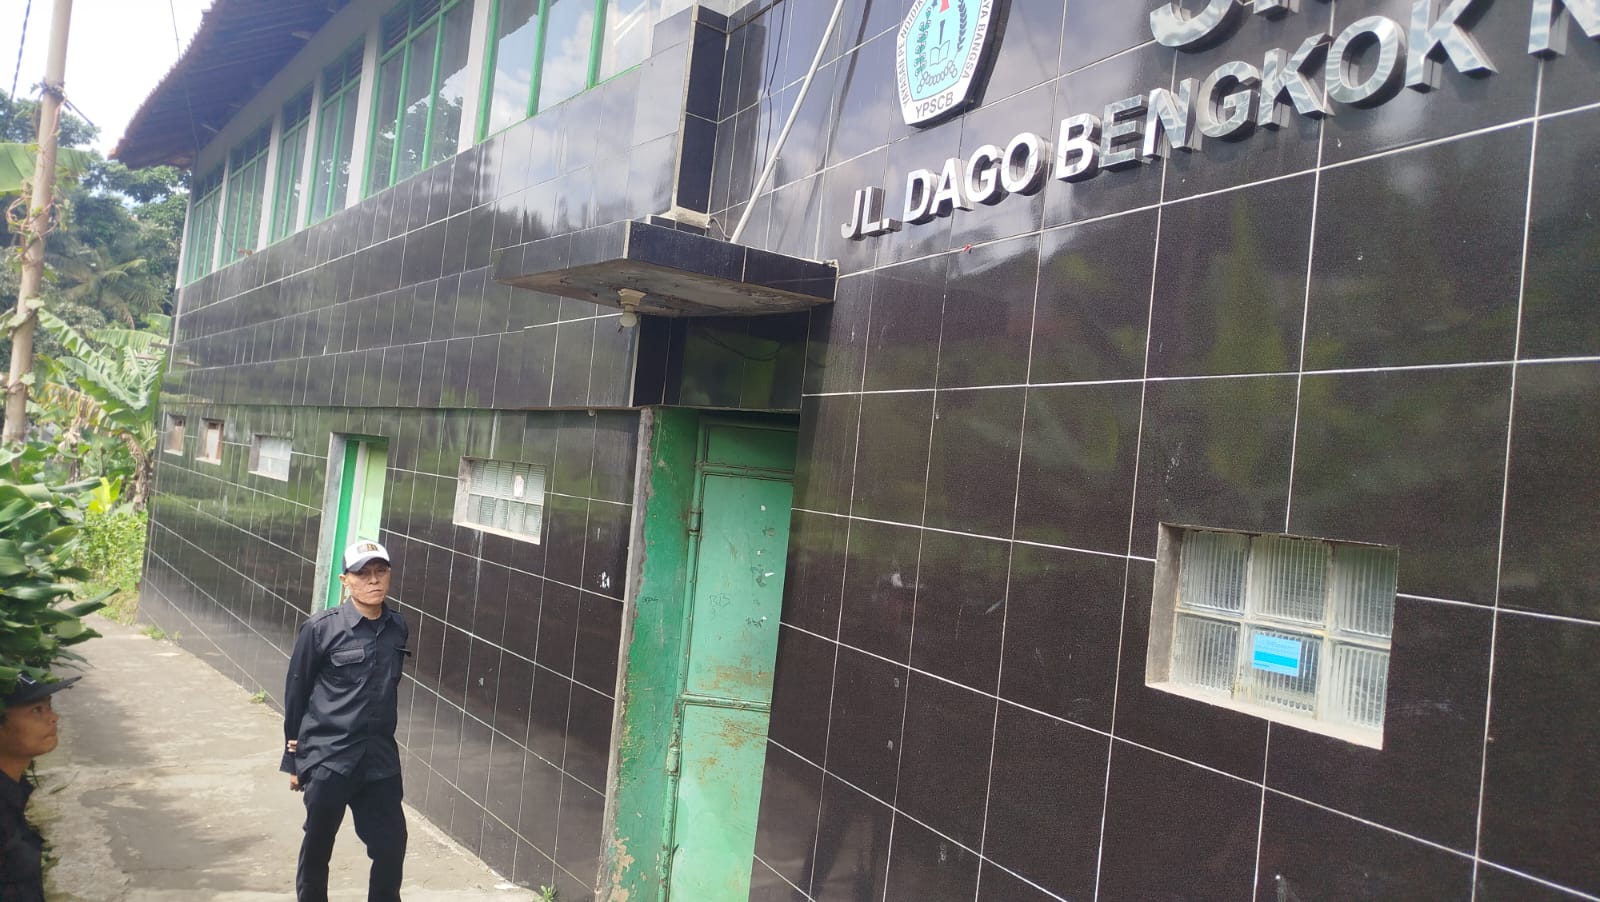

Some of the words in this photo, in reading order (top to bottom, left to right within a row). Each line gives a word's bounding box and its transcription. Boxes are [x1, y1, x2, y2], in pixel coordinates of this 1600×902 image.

[961, 23, 985, 79] BANGSA
[904, 132, 1052, 224] DAGO
[1056, 0, 1497, 181] BENGKOK
[915, 91, 954, 119] YPSCB
